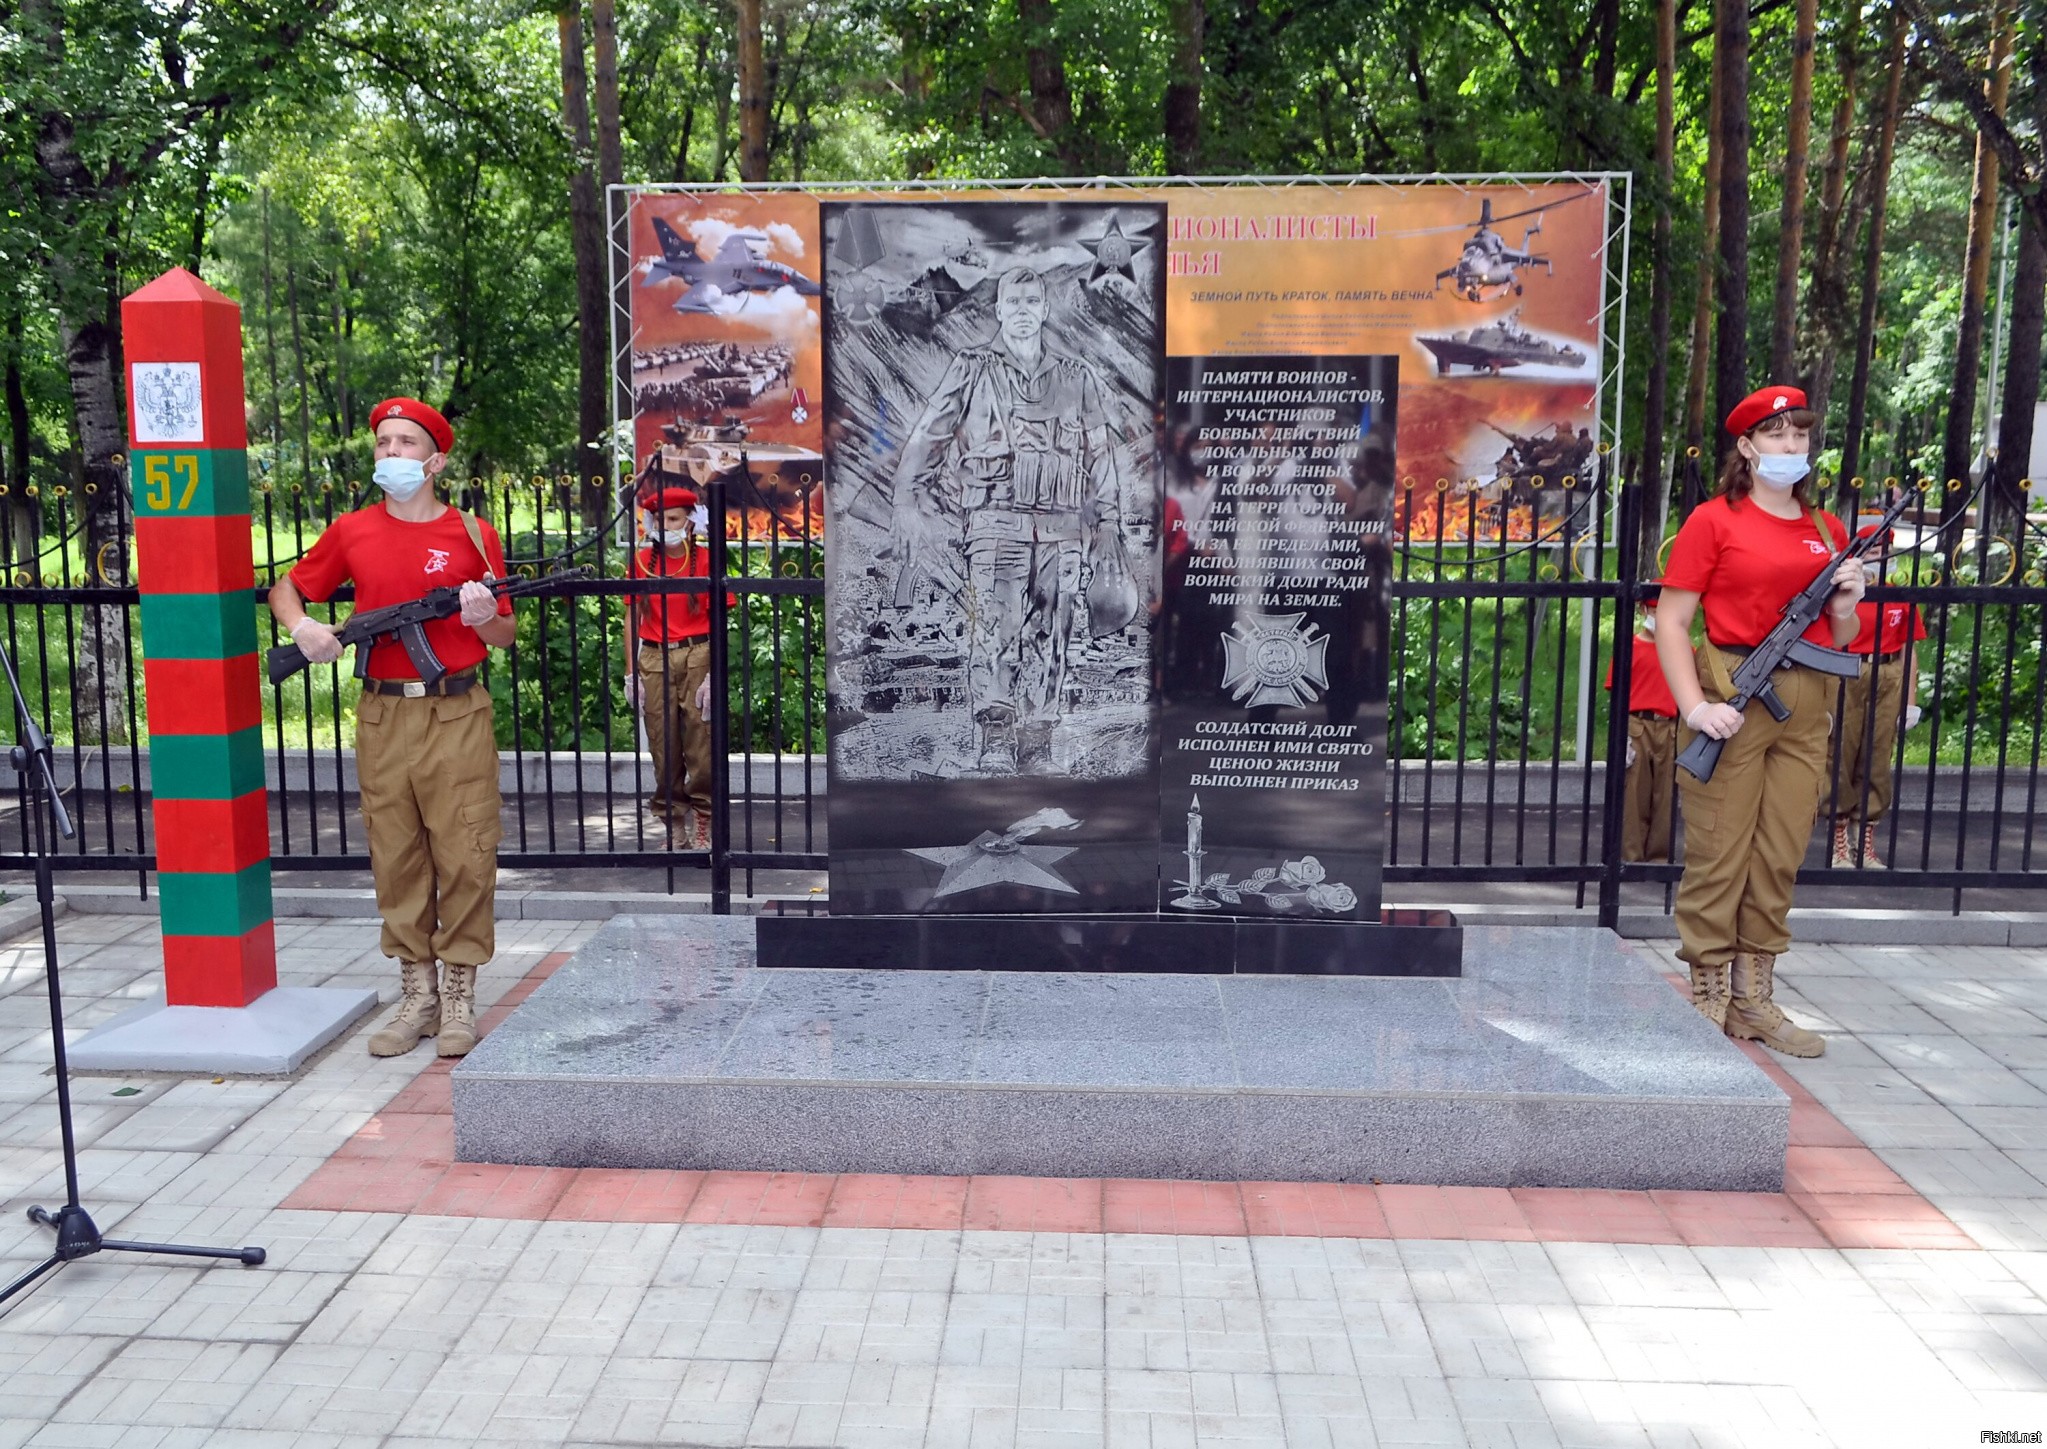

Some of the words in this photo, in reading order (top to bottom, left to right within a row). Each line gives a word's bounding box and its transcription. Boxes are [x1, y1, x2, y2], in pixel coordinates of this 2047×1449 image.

[1167, 214, 1378, 246] ИОНАЛИСТЫ
[1190, 290, 1242, 302] ЗЕМНОЙ
[1246, 291, 1279, 301] ПУТЬ
[1335, 291, 1388, 301] ПАМЯТЬ
[1202, 370, 1274, 385] ПАМЯТИ
[1276, 371, 1347, 384] ВОИНОВ
[1176, 389, 1385, 405] ИНТЕРНАЦИОНАЛИСТОВ,
[1223, 408, 1337, 422] УЧАСТНИКОВ
[1199, 427, 1268, 440] БОЕВЫХ
[1269, 424, 1361, 441] ДЕЙСТВИЙ
[1200, 446, 1307, 459] ЛОКАЛЬНЫХ
[1311, 442, 1358, 459] ВОЙН
[1206, 465, 1218, 477] И
[144, 455, 199, 510] 57
[1220, 483, 1337, 496] КОНФЛИКТОВ
[1210, 502, 1232, 514] НА
[1237, 501, 1347, 515] ТЕРРИТОРИИ
[1172, 516, 1280, 533] РОССИЙСКОЙ
[1285, 520, 1385, 536] ФЕДЕРАЦИИ
[1194, 538, 1206, 550] И
[1209, 538, 1229, 550] ЗА
[1256, 538, 1361, 554] ПРЕДЕЛАМИ,
[1188, 556, 1318, 570] ИСПОЛНЯВШИХ
[1321, 554, 1366, 570] СВОЙ
[1184, 572, 1276, 588] ВОИНСКИЙ
[1278, 576, 1323, 590] ДОЛГ
[1325, 576, 1369, 590] РАДИ
[1208, 593, 1251, 605] МИРА
[1258, 593, 1280, 605] НА
[1283, 594, 1342, 607] ЗЕМЛЕ.
[1195, 721, 1307, 737] СОЛДАТСКИЙ
[1309, 724, 1357, 739] ДОЛГ
[1178, 738, 1270, 752] ИСПОЛНЕН
[1273, 741, 1315, 753] ИМИ
[1317, 742, 1374, 756] СВЯТО
[1209, 757, 1273, 771] ЦЕНОЮ
[1275, 759, 1341, 773] ЖИЗНИ
[1189, 774, 1289, 788] ВЫПОЛНЕН
[1290, 777, 1360, 791] ПРИКАЗ
